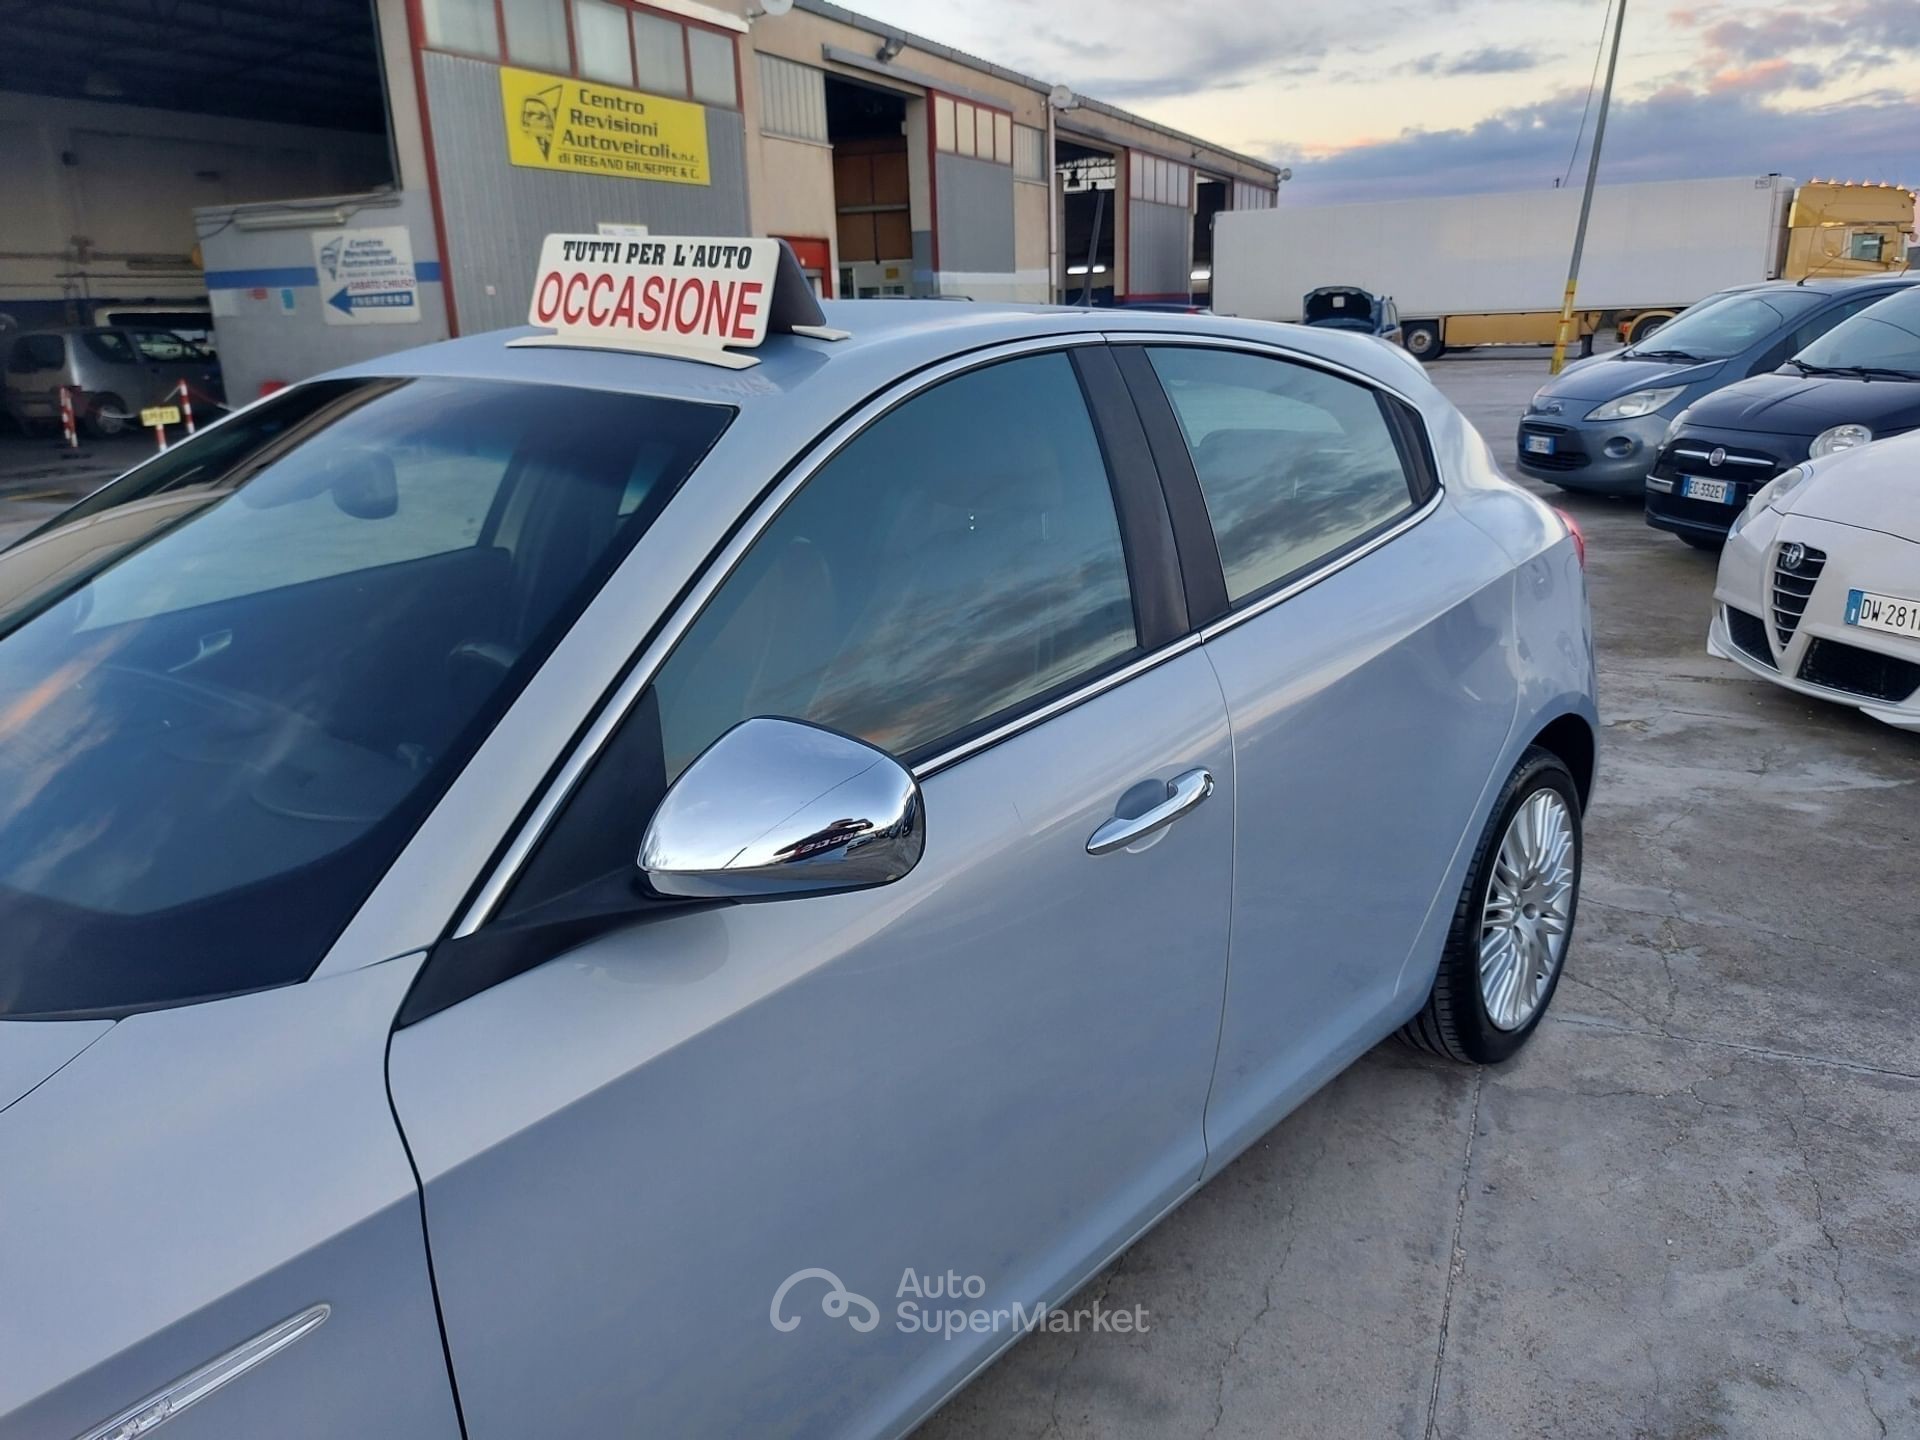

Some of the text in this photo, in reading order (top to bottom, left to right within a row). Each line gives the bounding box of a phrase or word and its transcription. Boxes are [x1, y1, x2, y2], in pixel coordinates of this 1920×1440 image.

[579, 88, 645, 114] Centro
[570, 108, 658, 137] Revisioni
[561, 129, 670, 159] Autoveicoli
[558, 152, 571, 164] di
[626, 160, 678, 177] GIUSEPPE
[563, 240, 753, 270] TUTTI PER L'AUTO
[537, 271, 763, 340] OCCASIONE
[1885, 604, 1920, 631] 281
